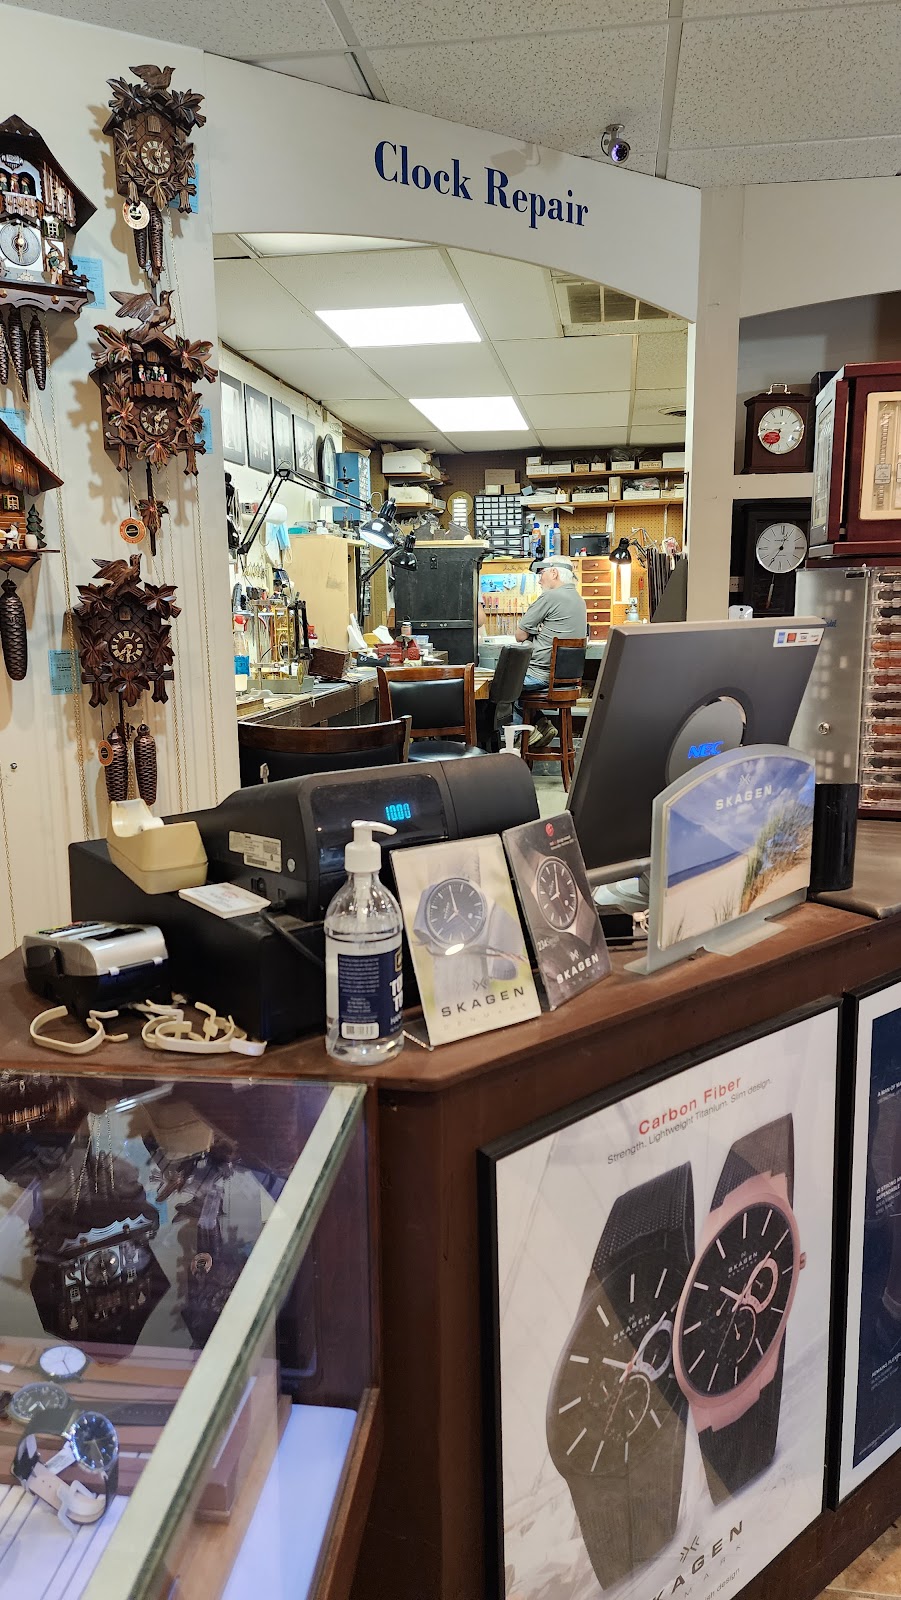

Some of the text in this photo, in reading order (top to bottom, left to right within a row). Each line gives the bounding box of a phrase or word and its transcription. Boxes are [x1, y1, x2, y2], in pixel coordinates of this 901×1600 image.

[375, 140, 588, 229] Clock Repair
[688, 741, 724, 758] NEC
[715, 784, 772, 810] SKAGEN
[557, 953, 599, 984] SKAGEN
[441, 986, 524, 1017] SKAGEN
[638, 1077, 741, 1135] Carbon Fiber
